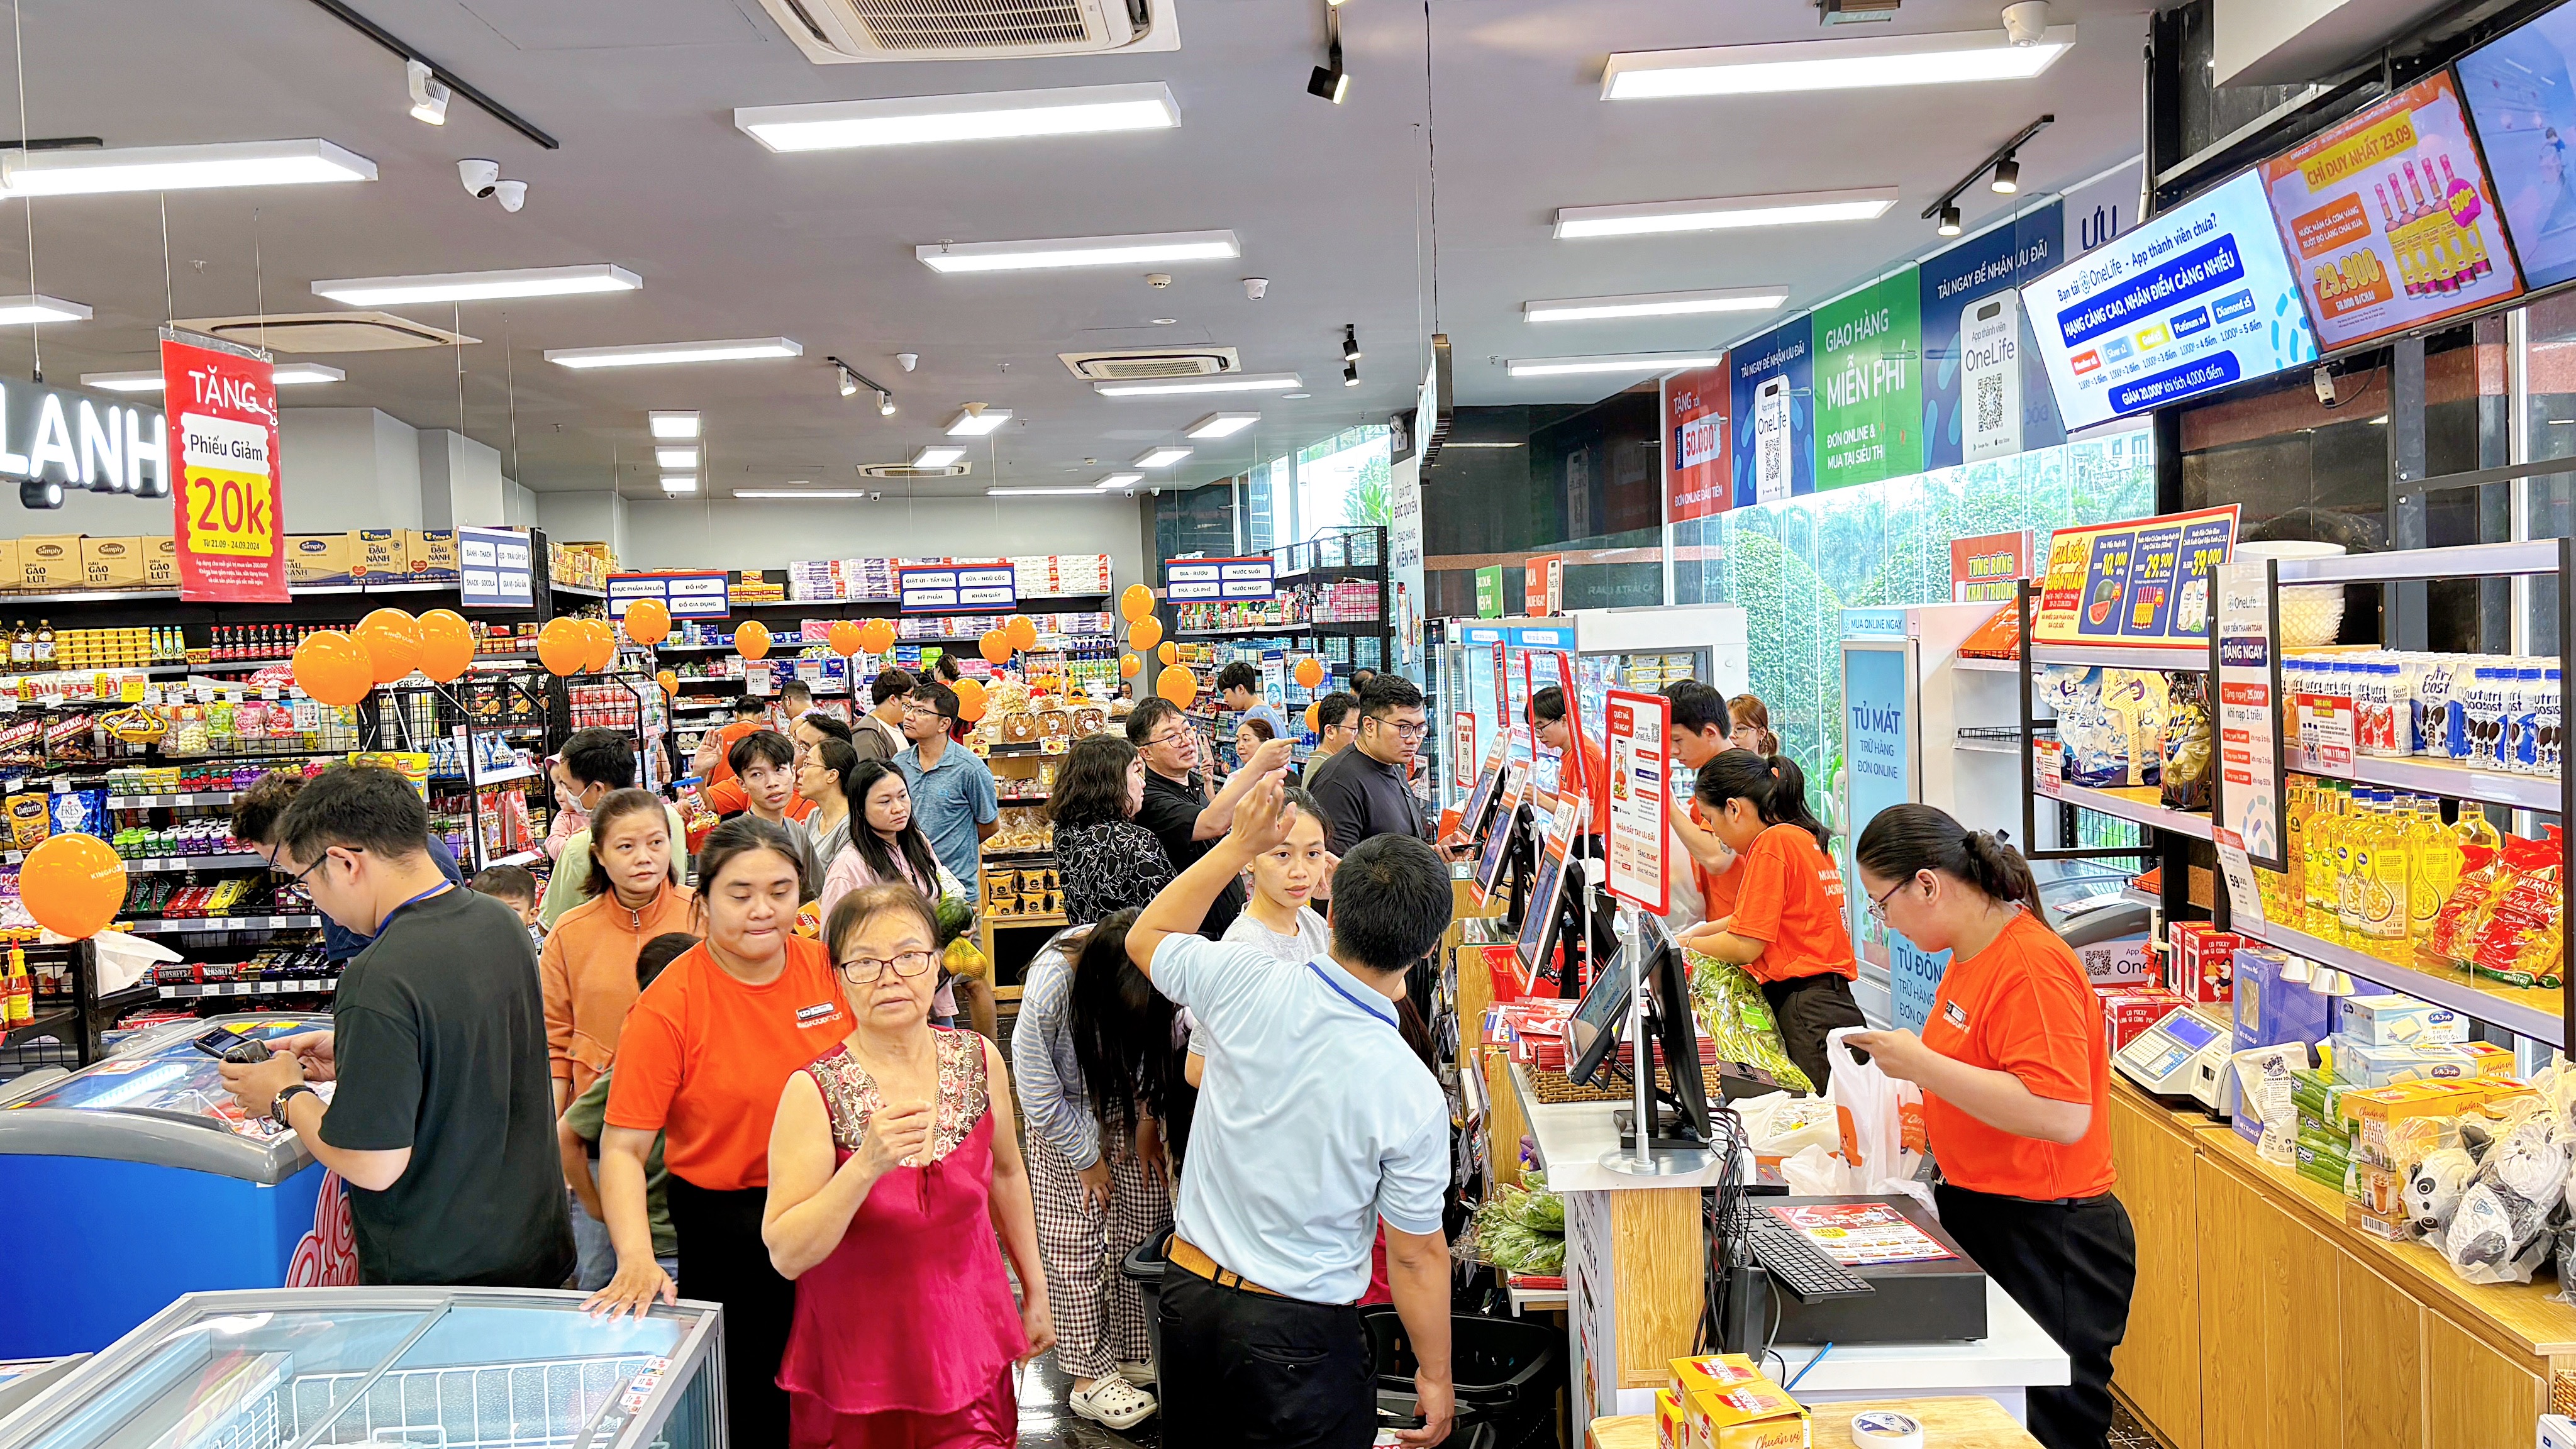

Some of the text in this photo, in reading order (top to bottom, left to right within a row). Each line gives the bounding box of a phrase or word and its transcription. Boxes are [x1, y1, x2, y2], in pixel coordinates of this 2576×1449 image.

[2307, 124, 2411, 186] CHỈ DUY NHẤT 23.09
[2082, 204, 2117, 250] ƯU
[2298, 226, 2312, 238] NƯỚC
[2345, 206, 2359, 219] VÀNG
[2302, 238, 2316, 249] RUỘT
[2058, 213, 2217, 303] Bạn tải OneLife App thành viên chưa?
[1938, 238, 2048, 299] TẢI NGAY ĐỂ NHẬN ƯU ĐÃI
[2313, 248, 2380, 299] 29.900
[2063, 316, 2085, 340] HẠNG
[2085, 308, 2107, 328] CÀNG
[2106, 300, 2127, 319] CAO,
[2124, 286, 2151, 311] NHÂN
[2150, 274, 2175, 301] ĐIỂM
[2175, 267, 2204, 290] CÀNG
[2216, 299, 2243, 318] Diamond
[1826, 308, 1889, 353] GIAO HÀNG
[1972, 331, 1981, 342] App
[1741, 342, 1804, 378] TẢI NGAY ĐỂ NHẬN ĐÃI
[1966, 338, 2014, 372] OneLife
[1827, 339, 1906, 411] MIỄN PHÍ
[189, 365, 257, 414] TẶNG
[2121, 388, 2141, 406] GIẢM
[2163, 379, 2174, 393] khi
[2174, 376, 2185, 391] tích
[2187, 369, 2205, 391] 4,000
[2206, 365, 2224, 384] điểm
[1674, 391, 1692, 418] TẶNG
[1758, 411, 1787, 435] OneLife
[1827, 425, 1875, 449] ĐƠN ONLINE &
[190, 434, 263, 462] Phiếu Giảm
[1828, 445, 1872, 470] MUA TẠI SIÊU
[194, 477, 265, 535] 20k
[1675, 494, 1684, 507] ĐƠN
[1684, 491, 1701, 505] ONLINE
[1701, 487, 1711, 501] ĐẦU
[37, 546, 62, 555] Simply
[99, 545, 124, 555] Simply
[203, 539, 260, 550] Từ 21.09 24.09.2024
[301, 541, 325, 552] Simply
[369, 545, 386, 555] ĐẬU
[431, 545, 447, 555] ĐẬU
[467, 548, 477, 557] BÁNH
[2053, 537, 2085, 565] GIÁ SỐC
[366, 552, 390, 563] NÀNH
[429, 552, 450, 562] NÀNH
[1966, 582, 1984, 601] KHAI
[2235, 597, 2256, 609] OneLife
[1851, 619, 1902, 630] MUA ONLINE NGAY
[2238, 624, 2250, 632] THANH
[2251, 623, 2262, 632] TOÁN
[2223, 641, 2263, 662] TẶNG NGAY
[2224, 687, 2235, 701] Tặng
[2235, 691, 2246, 702] ngay
[1613, 709, 1623, 719] QUÉT
[1852, 701, 1901, 735] TỦ MÁT
[2235, 709, 2245, 721] nạp
[2246, 709, 2250, 719] 1
[2250, 708, 2262, 721] triệu
[48, 714, 84, 736] KOPIKO
[1635, 731, 1650, 742] OneLife
[1860, 738, 1894, 757] TRỮ HÀNG
[1858, 760, 1897, 779] ĐƠN ONLINE
[15, 804, 42, 816] Tamarin
[61, 802, 79, 816] FRES
[221, 880, 236, 899] DARS
[2229, 874, 2240, 888] 59
[2516, 875, 2557, 896] MEIZAN
[177, 886, 199, 907] DARS
[1897, 945, 1912, 972] TỦ
[1899, 978, 1913, 998] TRỮ
[1900, 1001, 1916, 1022] ĐƠN
[2263, 1055, 2284, 1070] Sunlight
[2483, 1060, 2505, 1074] Chuẩn
[2359, 1105, 2379, 1118] Chuẩn
[2364, 1118, 2382, 1132] PHA
[2363, 1129, 2386, 1146] PHIN
[1755, 1430, 1801, 1449] Chuẩn vị
